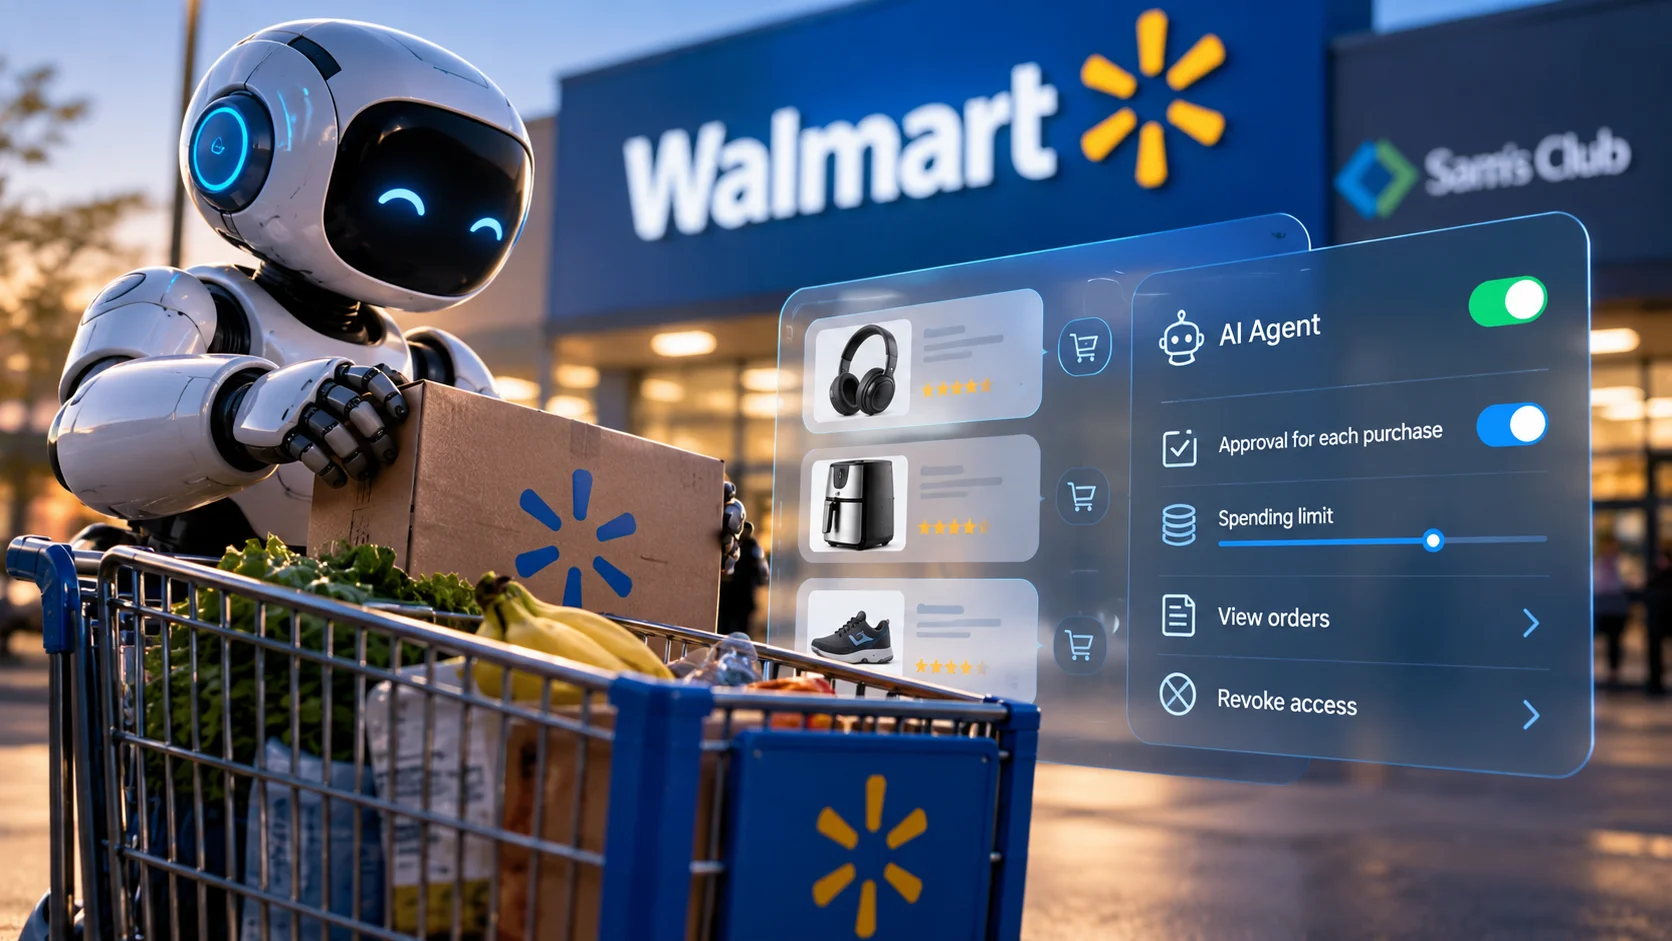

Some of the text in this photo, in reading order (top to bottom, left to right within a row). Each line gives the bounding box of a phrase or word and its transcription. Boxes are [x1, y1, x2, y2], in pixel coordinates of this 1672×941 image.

[623, 62, 1058, 242] Walmart
[1534, 126, 1632, 182] Club
[1219, 313, 1321, 346] AI Agent
[1219, 422, 1443, 456] Approval for each purchase
[1218, 507, 1334, 530] Spending limit
[1218, 607, 1330, 628] View orders
[1217, 689, 1358, 716] Revoke access
